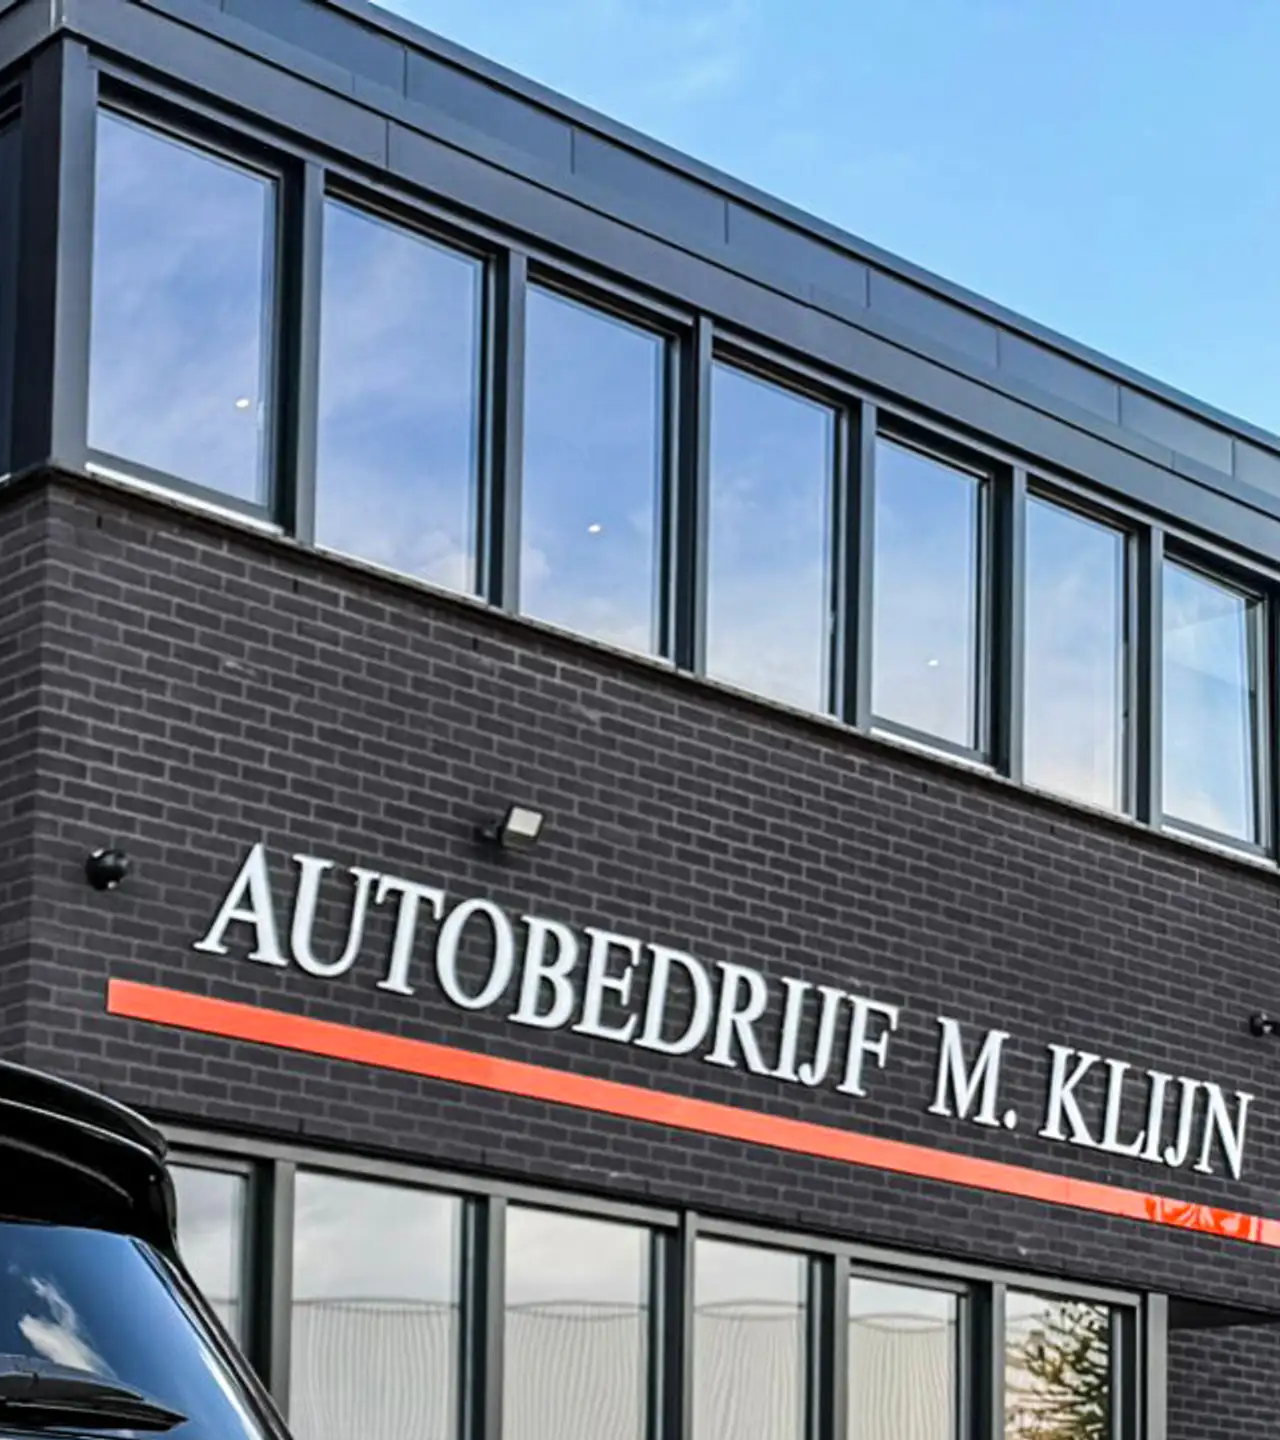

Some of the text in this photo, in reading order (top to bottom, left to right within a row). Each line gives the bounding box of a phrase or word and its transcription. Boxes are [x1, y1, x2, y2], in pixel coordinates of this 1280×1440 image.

[192, 842, 1256, 1182] AUTOBEDRIJF M. KLIJN
